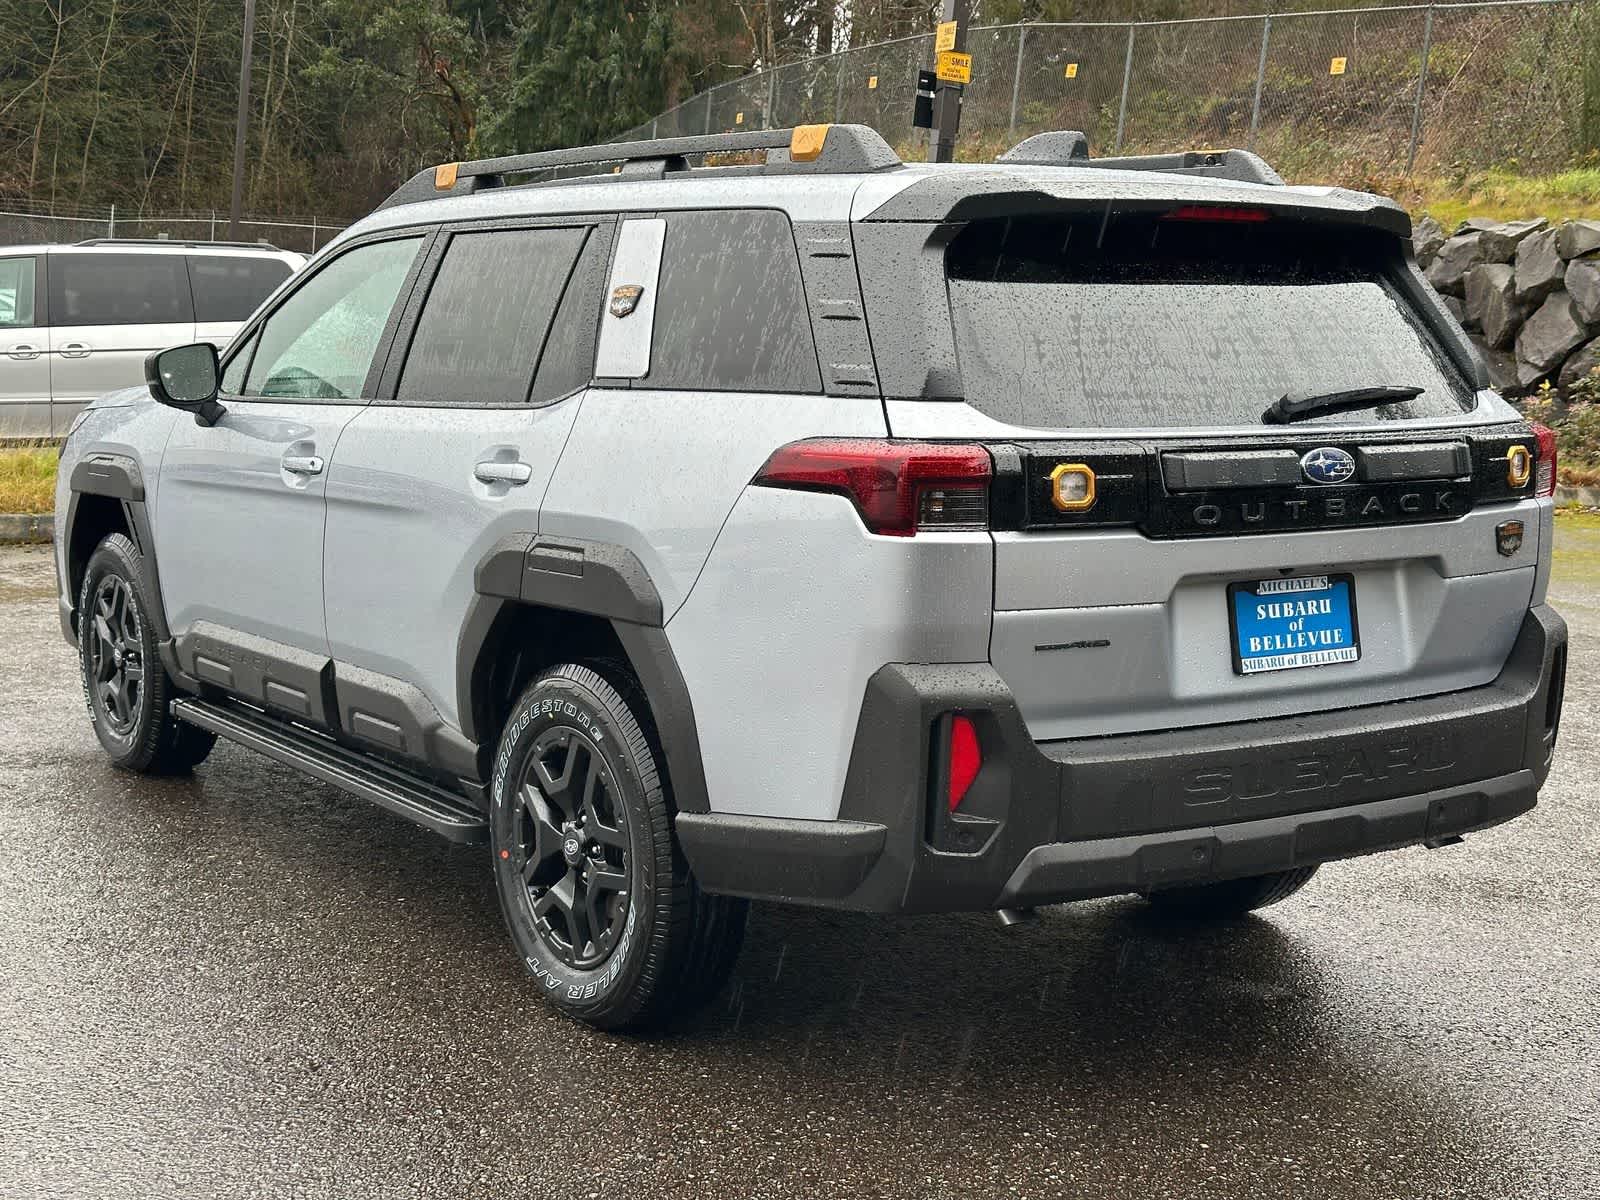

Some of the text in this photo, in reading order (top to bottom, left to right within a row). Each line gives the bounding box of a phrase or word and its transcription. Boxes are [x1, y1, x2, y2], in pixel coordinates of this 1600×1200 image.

[951, 57, 968, 68] SMILE
[1192, 491, 1452, 525] OUTBACK
[1260, 577, 1328, 593] MICHAEL'S
[1256, 599, 1332, 620] SUBARU
[1289, 618, 1305, 631] of
[1250, 628, 1344, 652] BELLEVUE
[1243, 649, 1357, 671] SUBARU of BELLEVUE
[1182, 741, 1457, 807] SUBARU
[526, 899, 636, 999] DUELER A/T
